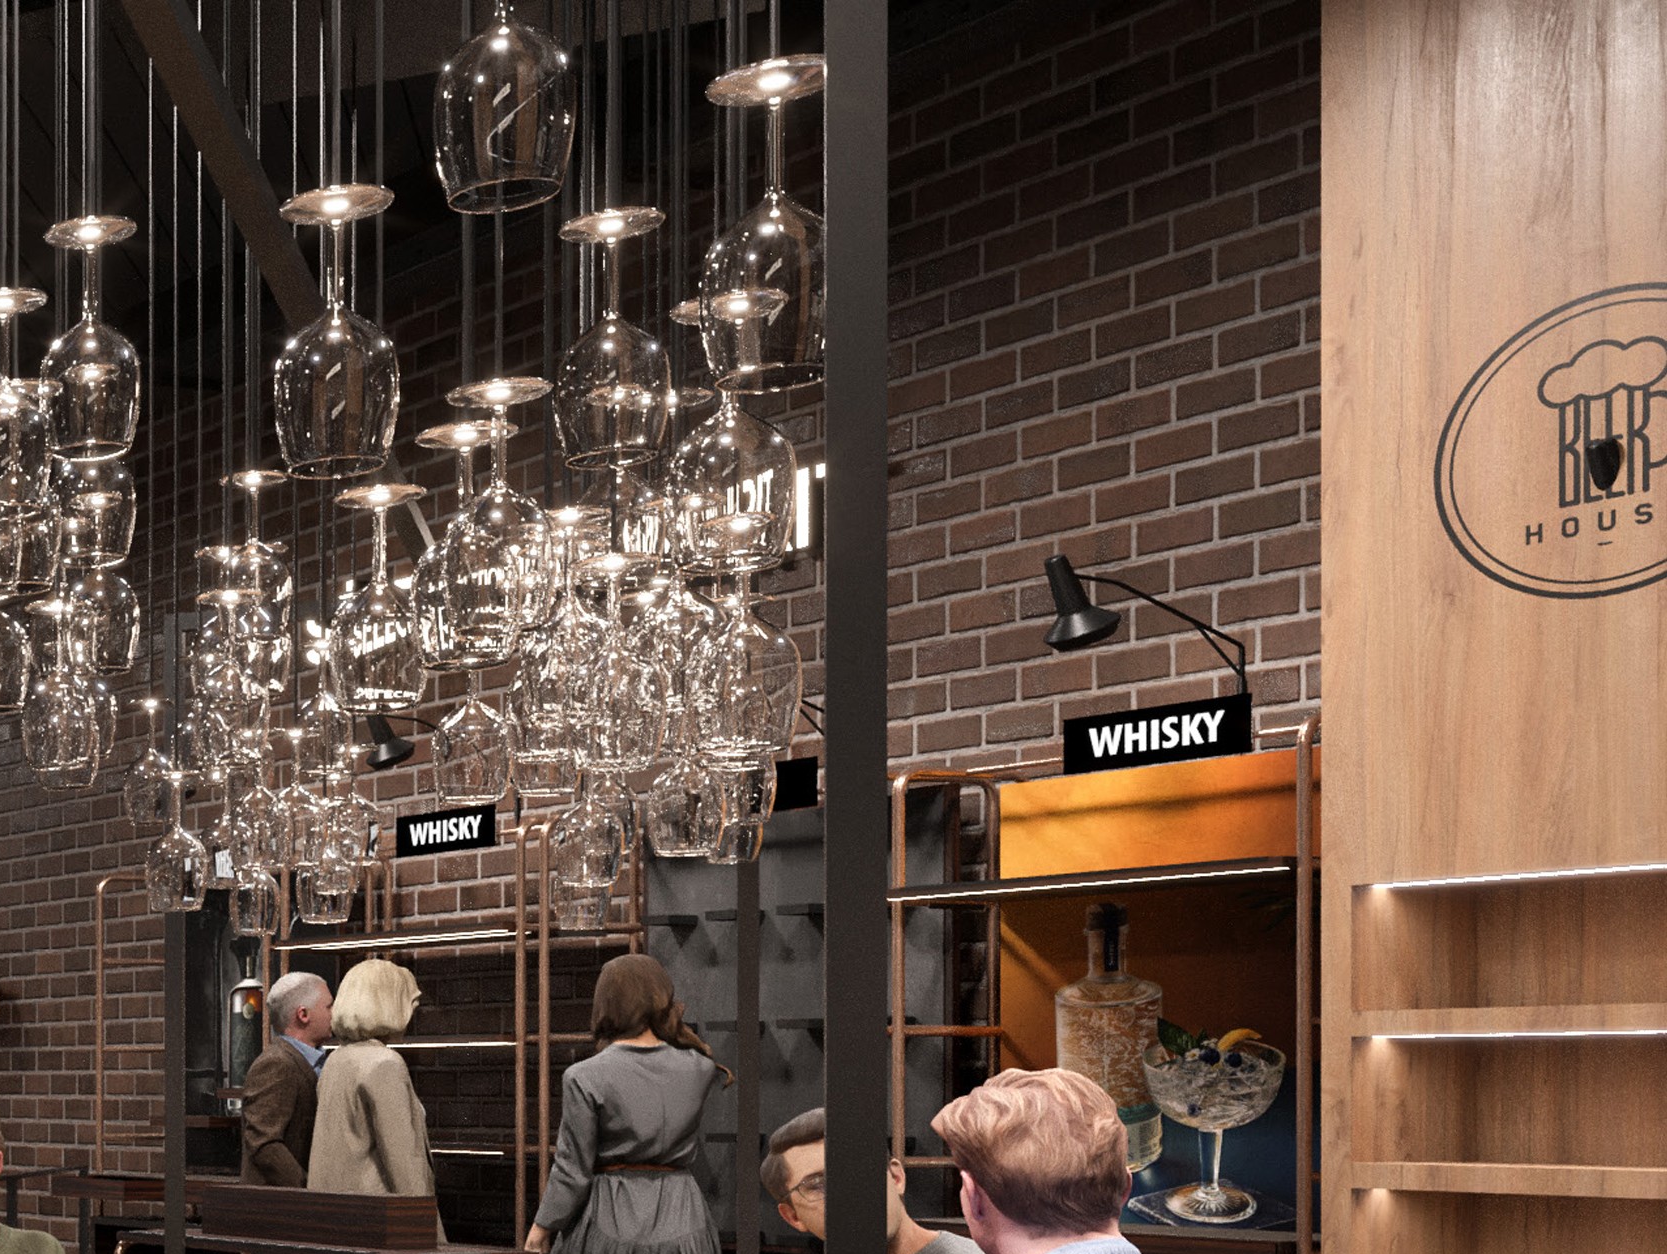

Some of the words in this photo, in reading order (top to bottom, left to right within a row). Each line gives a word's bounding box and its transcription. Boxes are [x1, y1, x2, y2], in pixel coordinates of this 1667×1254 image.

[1525, 502, 1654, 546] HOUS
[1088, 709, 1226, 758] WHISKY
[409, 814, 483, 847] WHISKY
